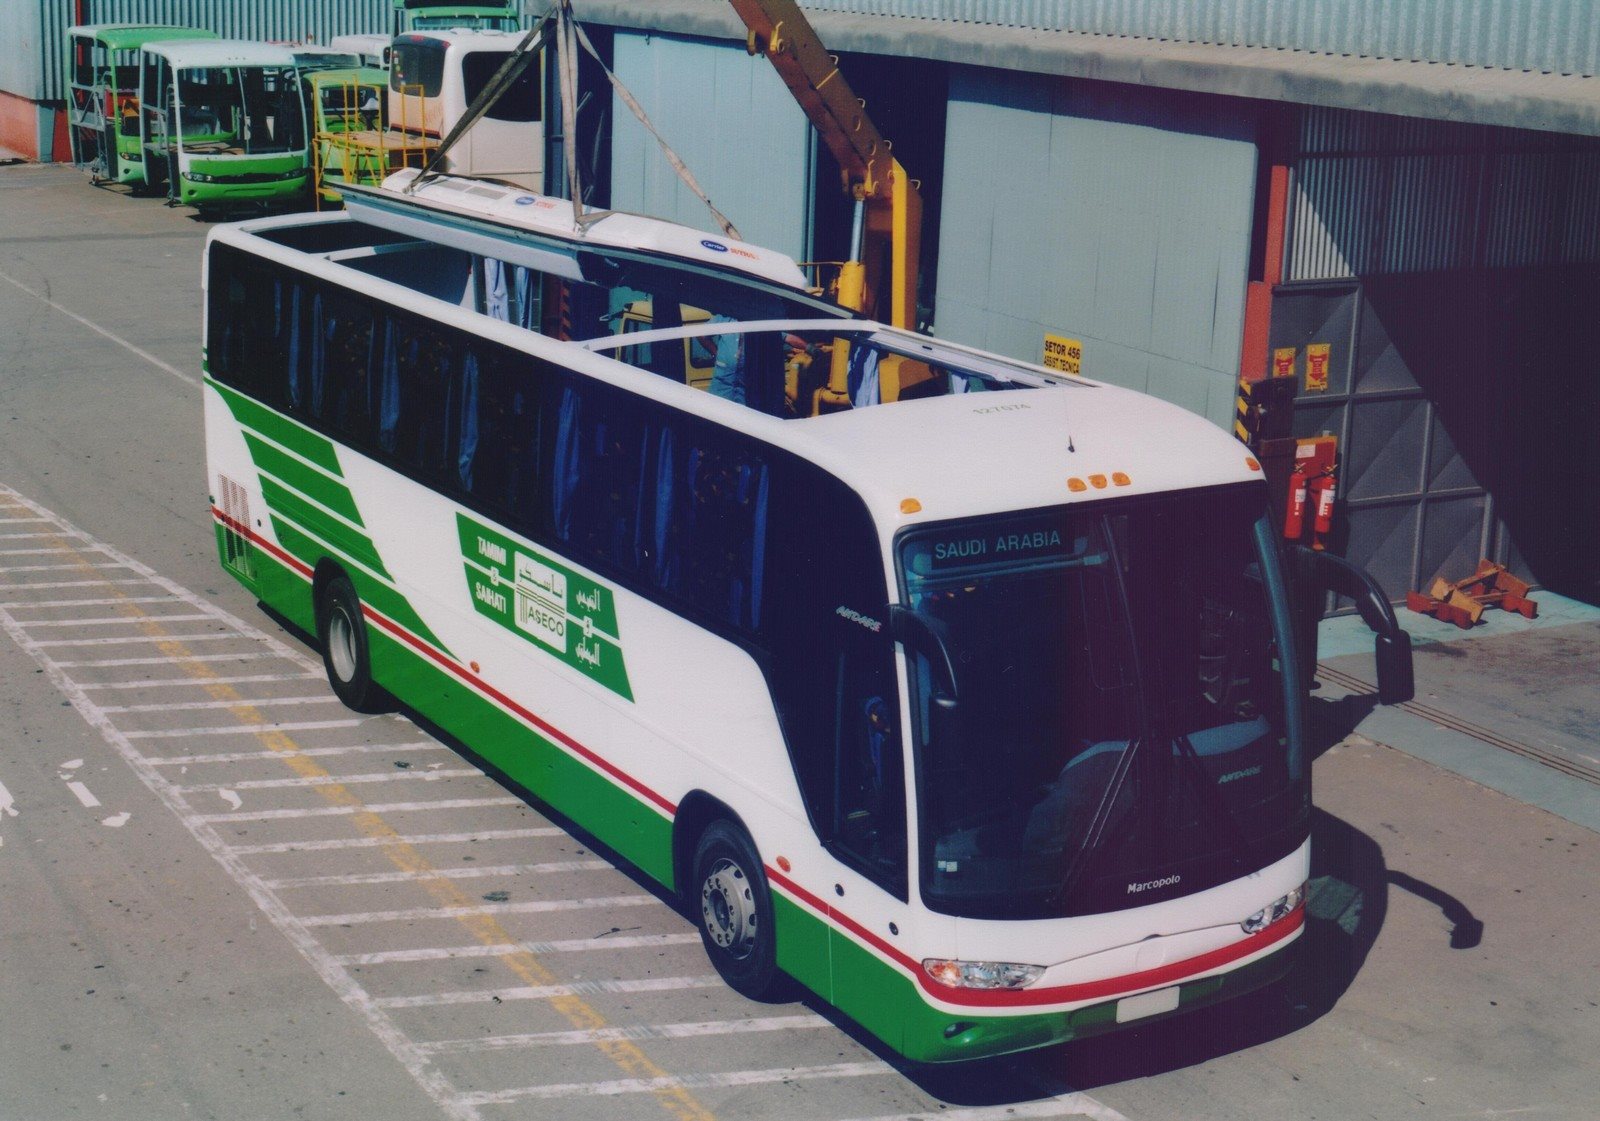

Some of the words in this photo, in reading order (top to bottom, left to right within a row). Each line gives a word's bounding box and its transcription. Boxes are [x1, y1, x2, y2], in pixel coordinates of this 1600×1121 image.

[702, 240, 728, 252] Carrier
[1044, 340, 1067, 357] SETOR
[1067, 346, 1081, 360] 456
[935, 539, 986, 560] SAUDI
[995, 530, 1061, 552] ARABIA
[1127, 875, 1181, 894] Marcopolo
